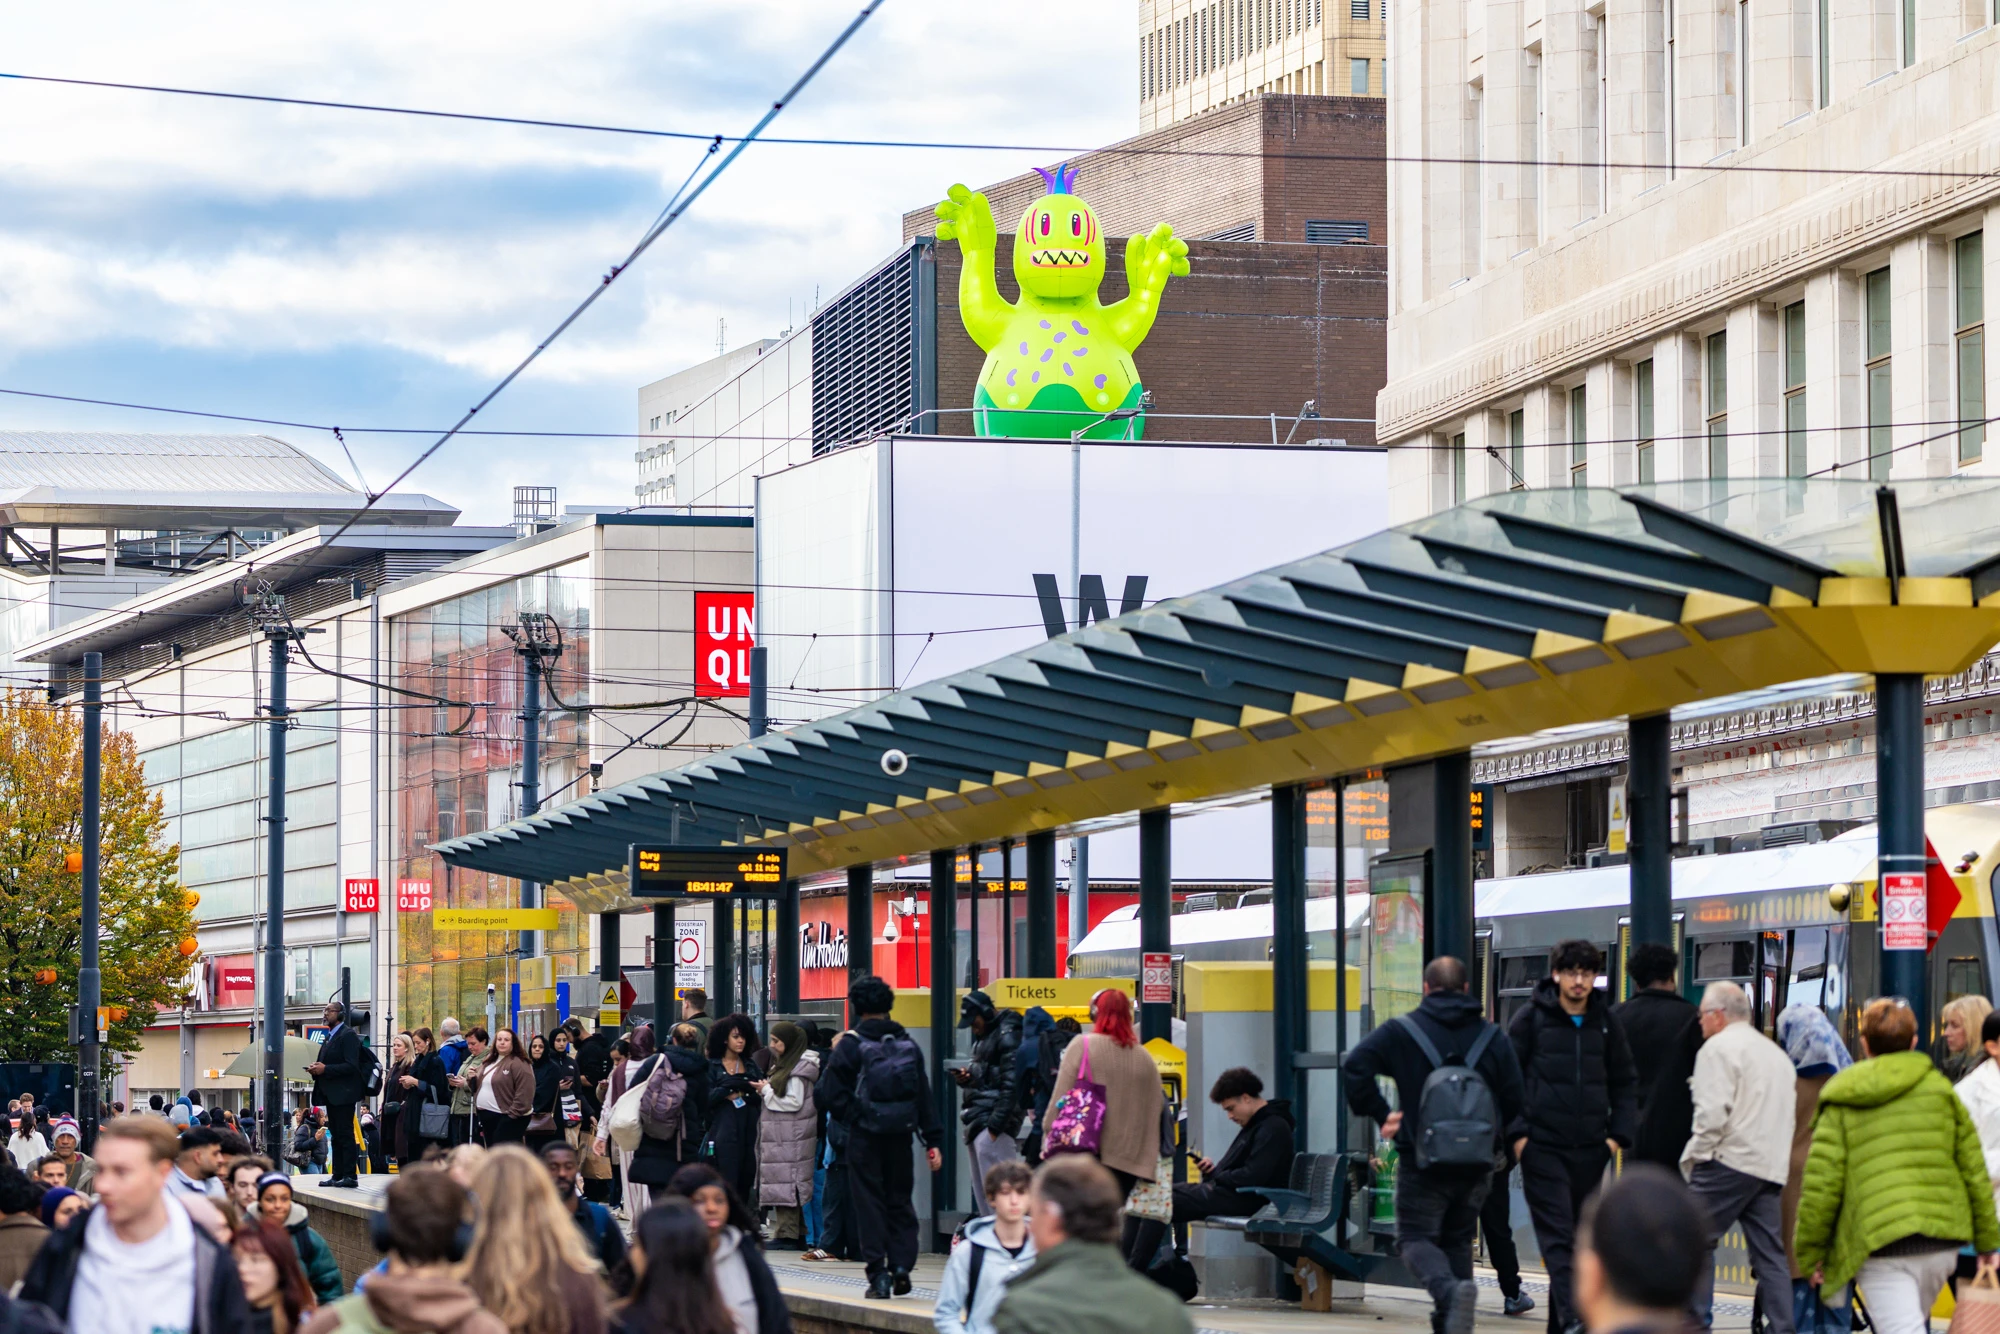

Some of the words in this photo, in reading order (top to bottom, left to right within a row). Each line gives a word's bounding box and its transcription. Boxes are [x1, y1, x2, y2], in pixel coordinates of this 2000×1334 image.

[1032, 573, 1148, 640] W
[708, 606, 754, 641] UN
[708, 649, 751, 690] QL
[640, 851, 660, 862] Bury
[757, 853, 763, 862] 4
[765, 854, 780, 862] min
[640, 861, 660, 872] Bury
[738, 864, 752, 872] dbl
[755, 864, 763, 872] 11
[765, 864, 780, 872] min
[349, 883, 373, 895] UNI
[687, 882, 733, 893] 16:41:47
[349, 896, 375, 909] QLO
[458, 917, 488, 926] Boarding
[490, 917, 508, 926] point
[799, 922, 817, 969] Tim
[816, 921, 849, 968] Horto
[1006, 985, 1056, 999] Tickets
